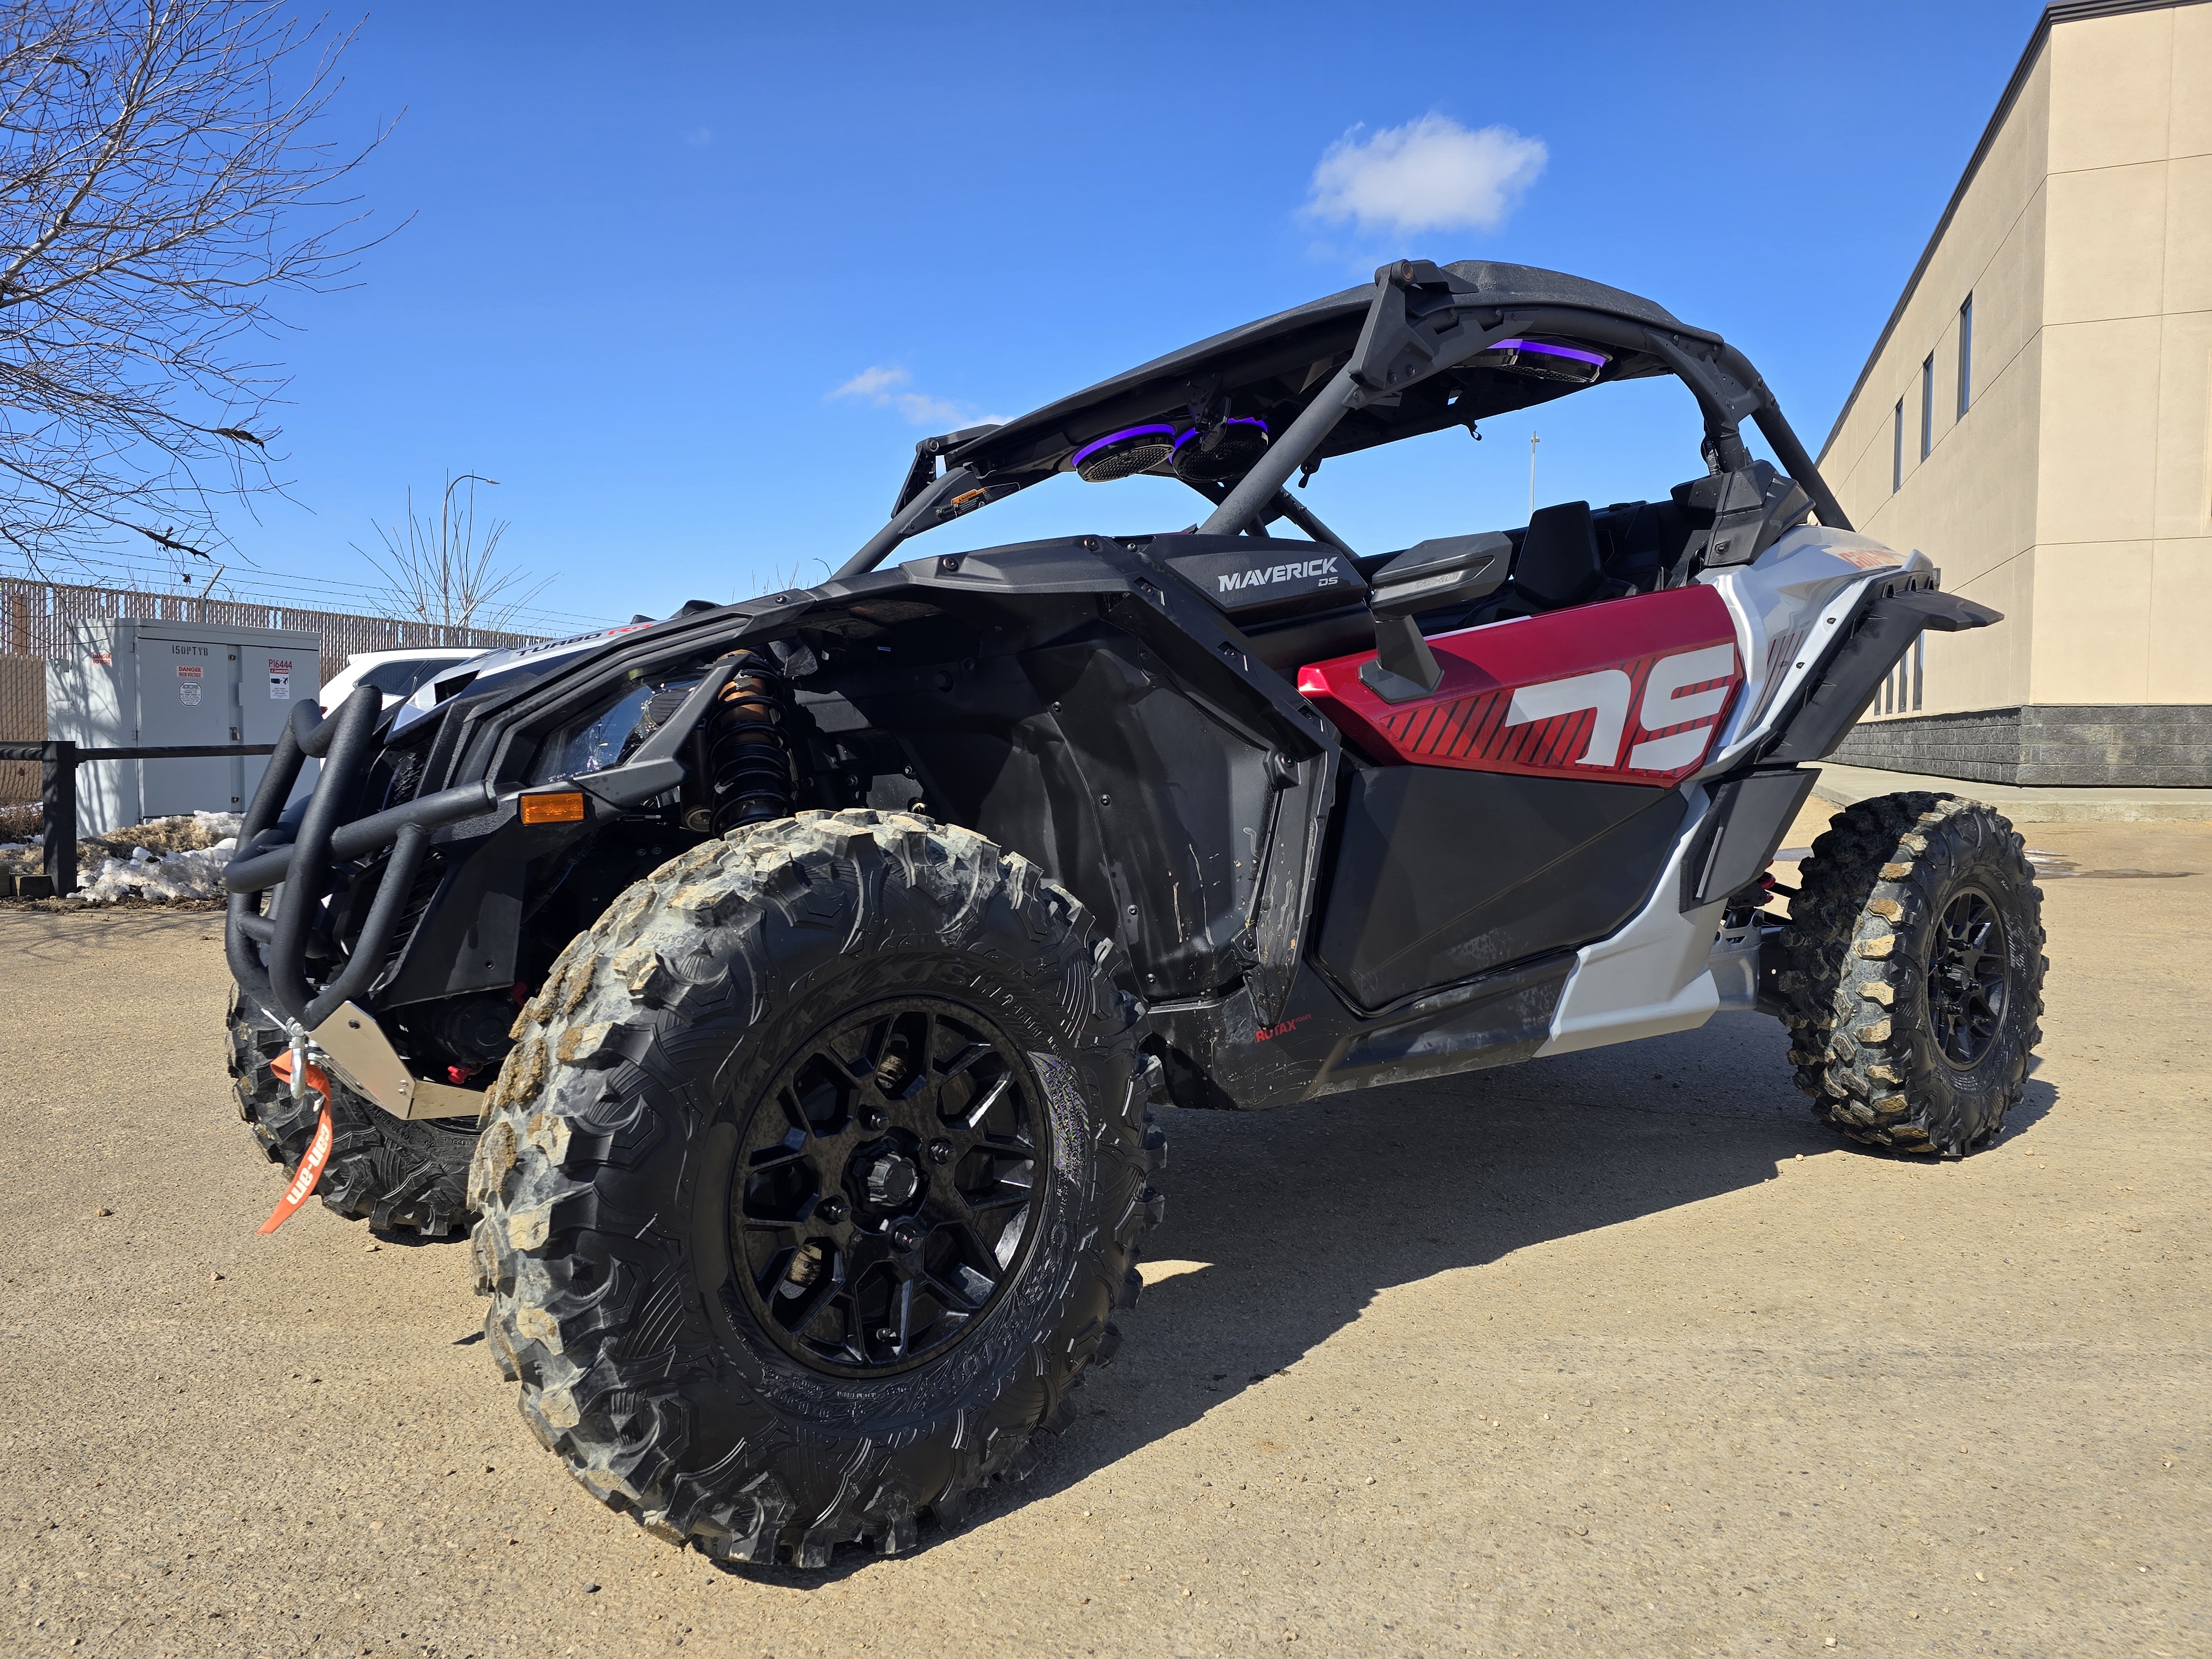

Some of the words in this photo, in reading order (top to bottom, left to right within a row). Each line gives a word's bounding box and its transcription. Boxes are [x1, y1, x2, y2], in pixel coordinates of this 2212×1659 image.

[1218, 556, 1338, 592] MAVERICK
[1318, 576, 1339, 587] DS
[1415, 572, 1458, 588] can-am
[515, 633, 602, 656] TURBO
[607, 624, 654, 636] RR
[268, 659, 292, 669] P16444
[1295, 1014, 1312, 1022] POWER
[286, 1123, 330, 1205] can-am
